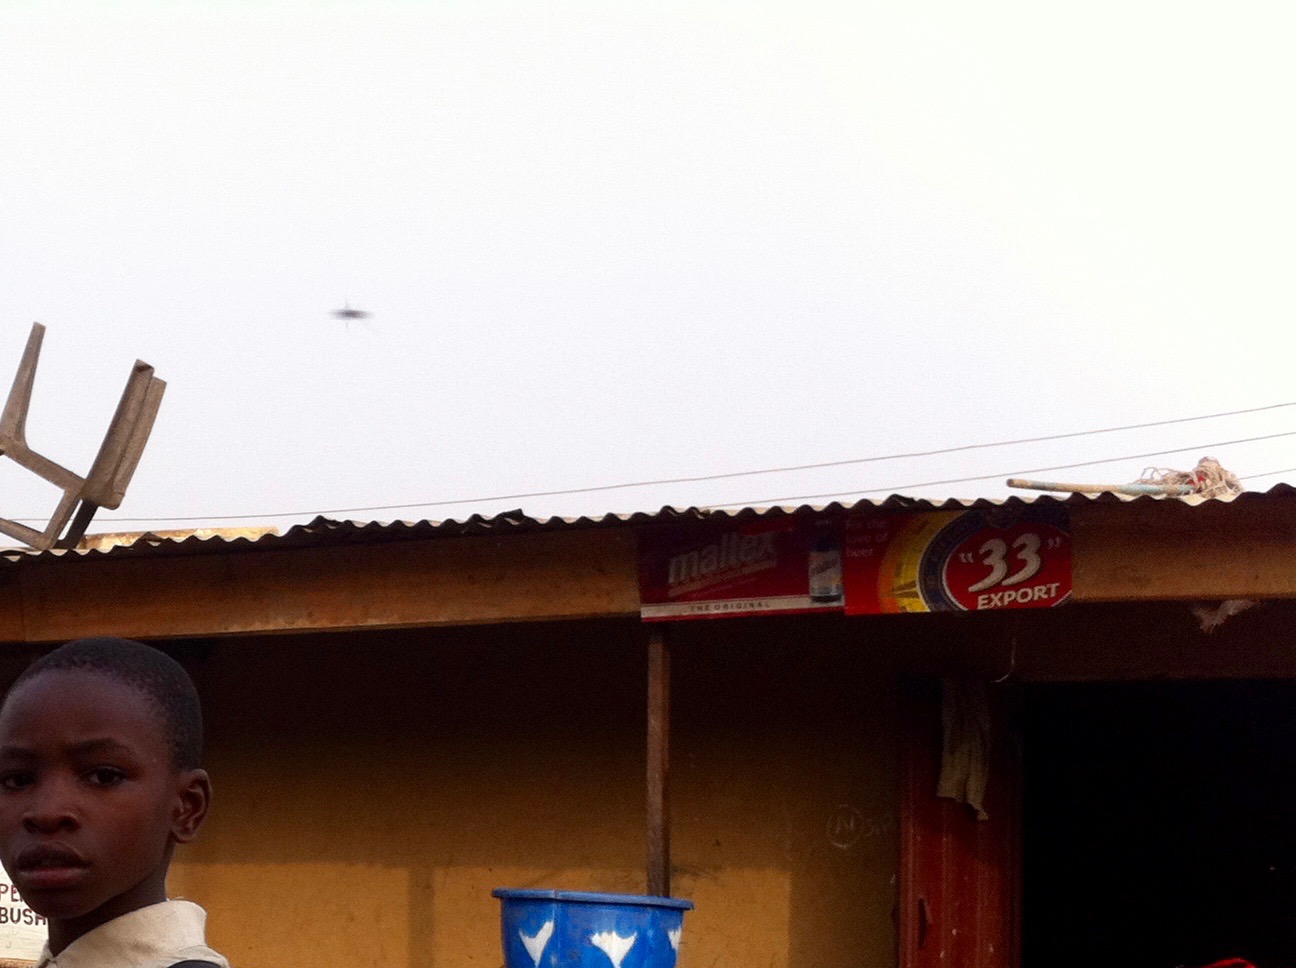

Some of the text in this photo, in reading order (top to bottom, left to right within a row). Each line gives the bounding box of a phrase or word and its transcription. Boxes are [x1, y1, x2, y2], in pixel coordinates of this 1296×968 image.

[977, 582, 1061, 610] EXPORT
[690, 601, 770, 612] THE ORIGINAL
